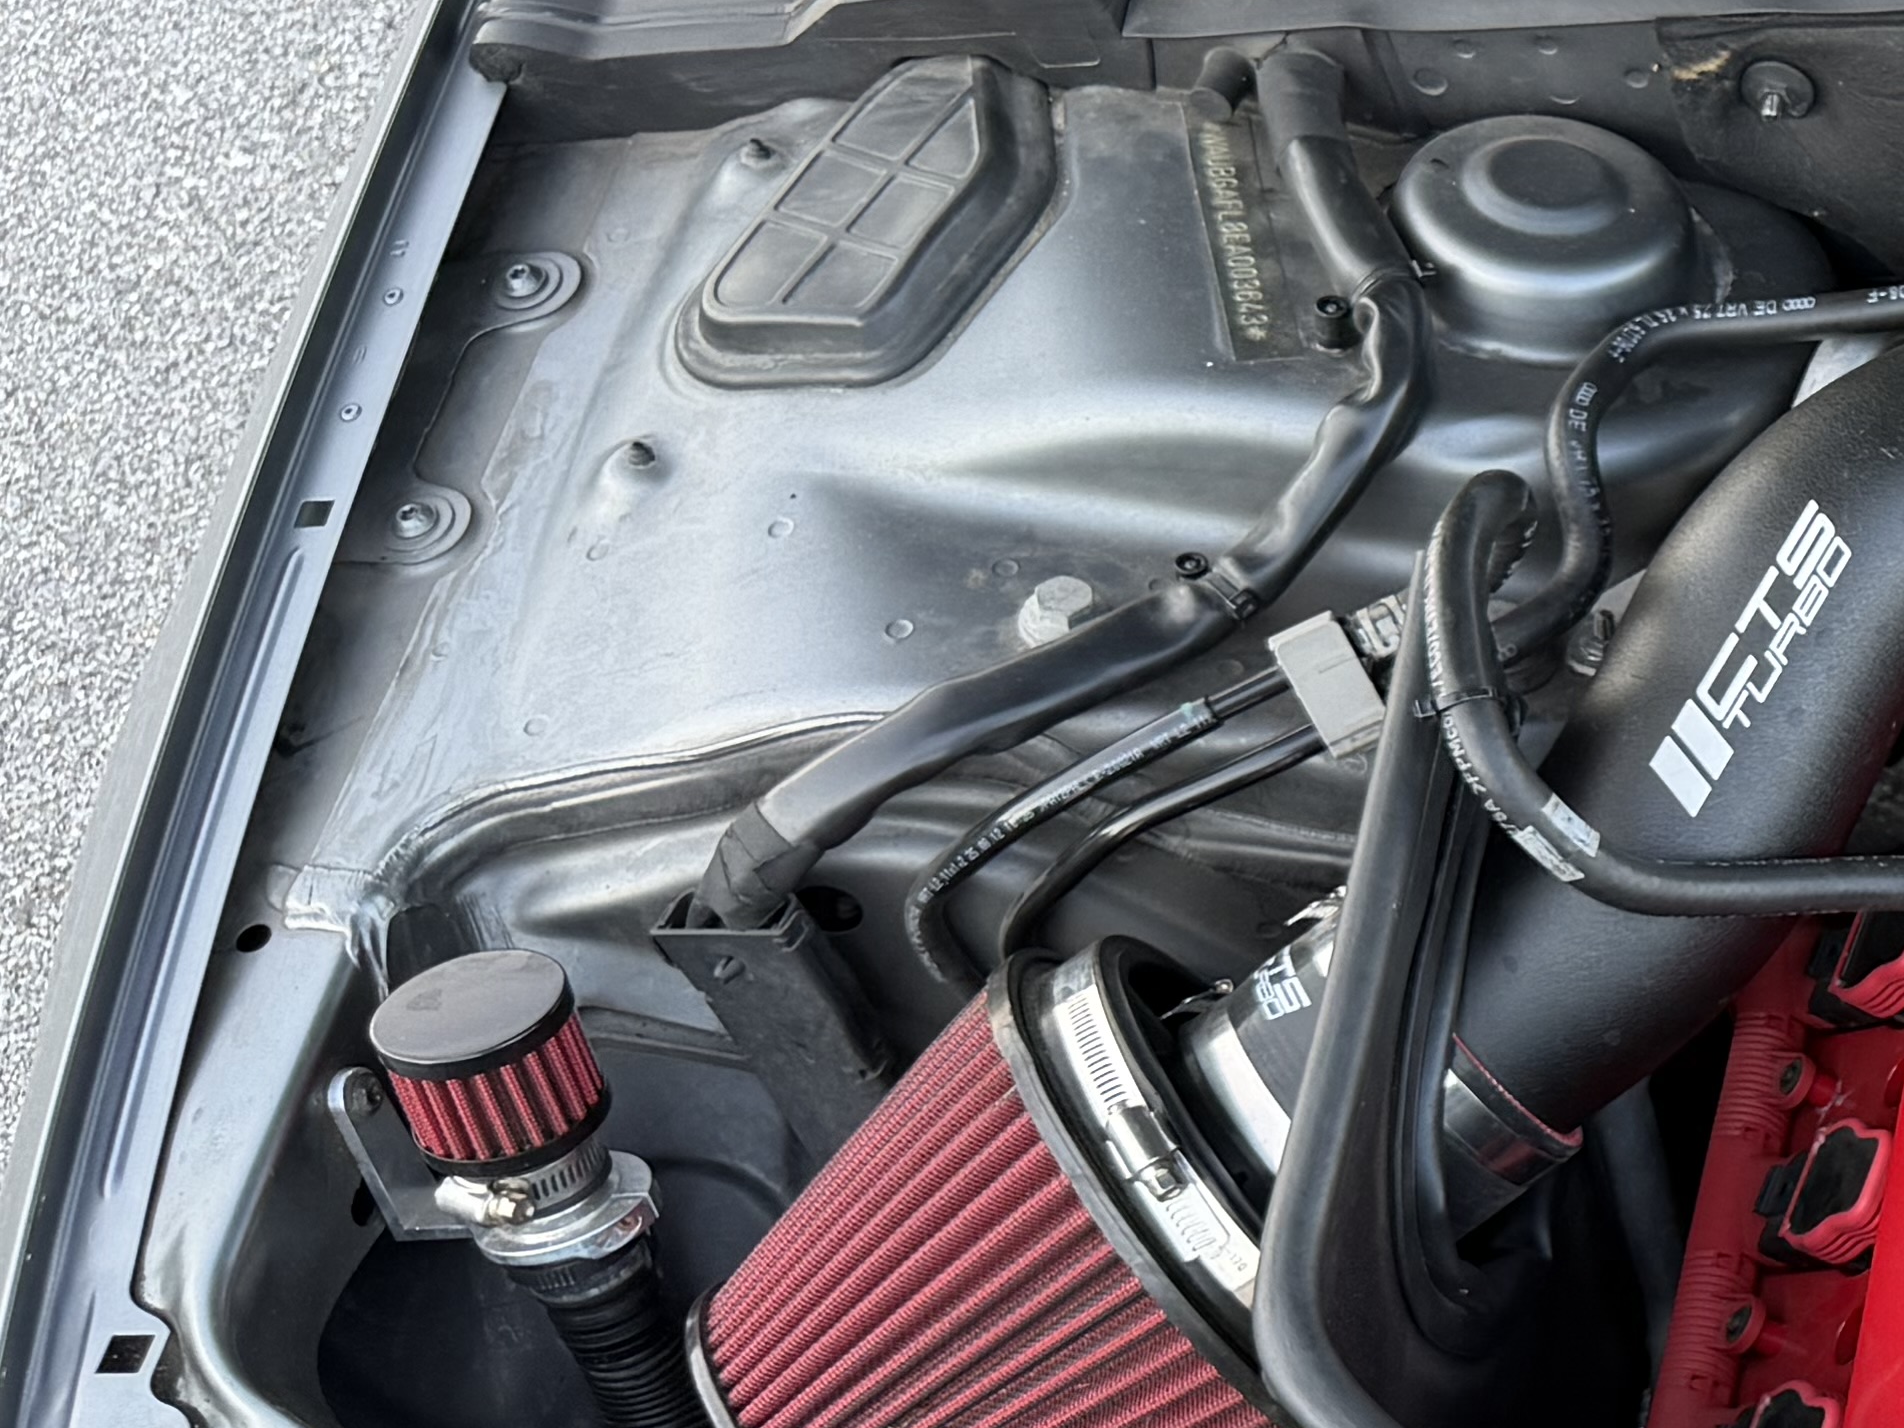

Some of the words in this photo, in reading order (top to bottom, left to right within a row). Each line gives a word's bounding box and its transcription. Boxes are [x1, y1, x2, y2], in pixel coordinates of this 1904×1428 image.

[1696, 499, 1836, 721] CTS
[1722, 536, 1852, 729] TURBO
[1267, 944, 1312, 1014] TS
